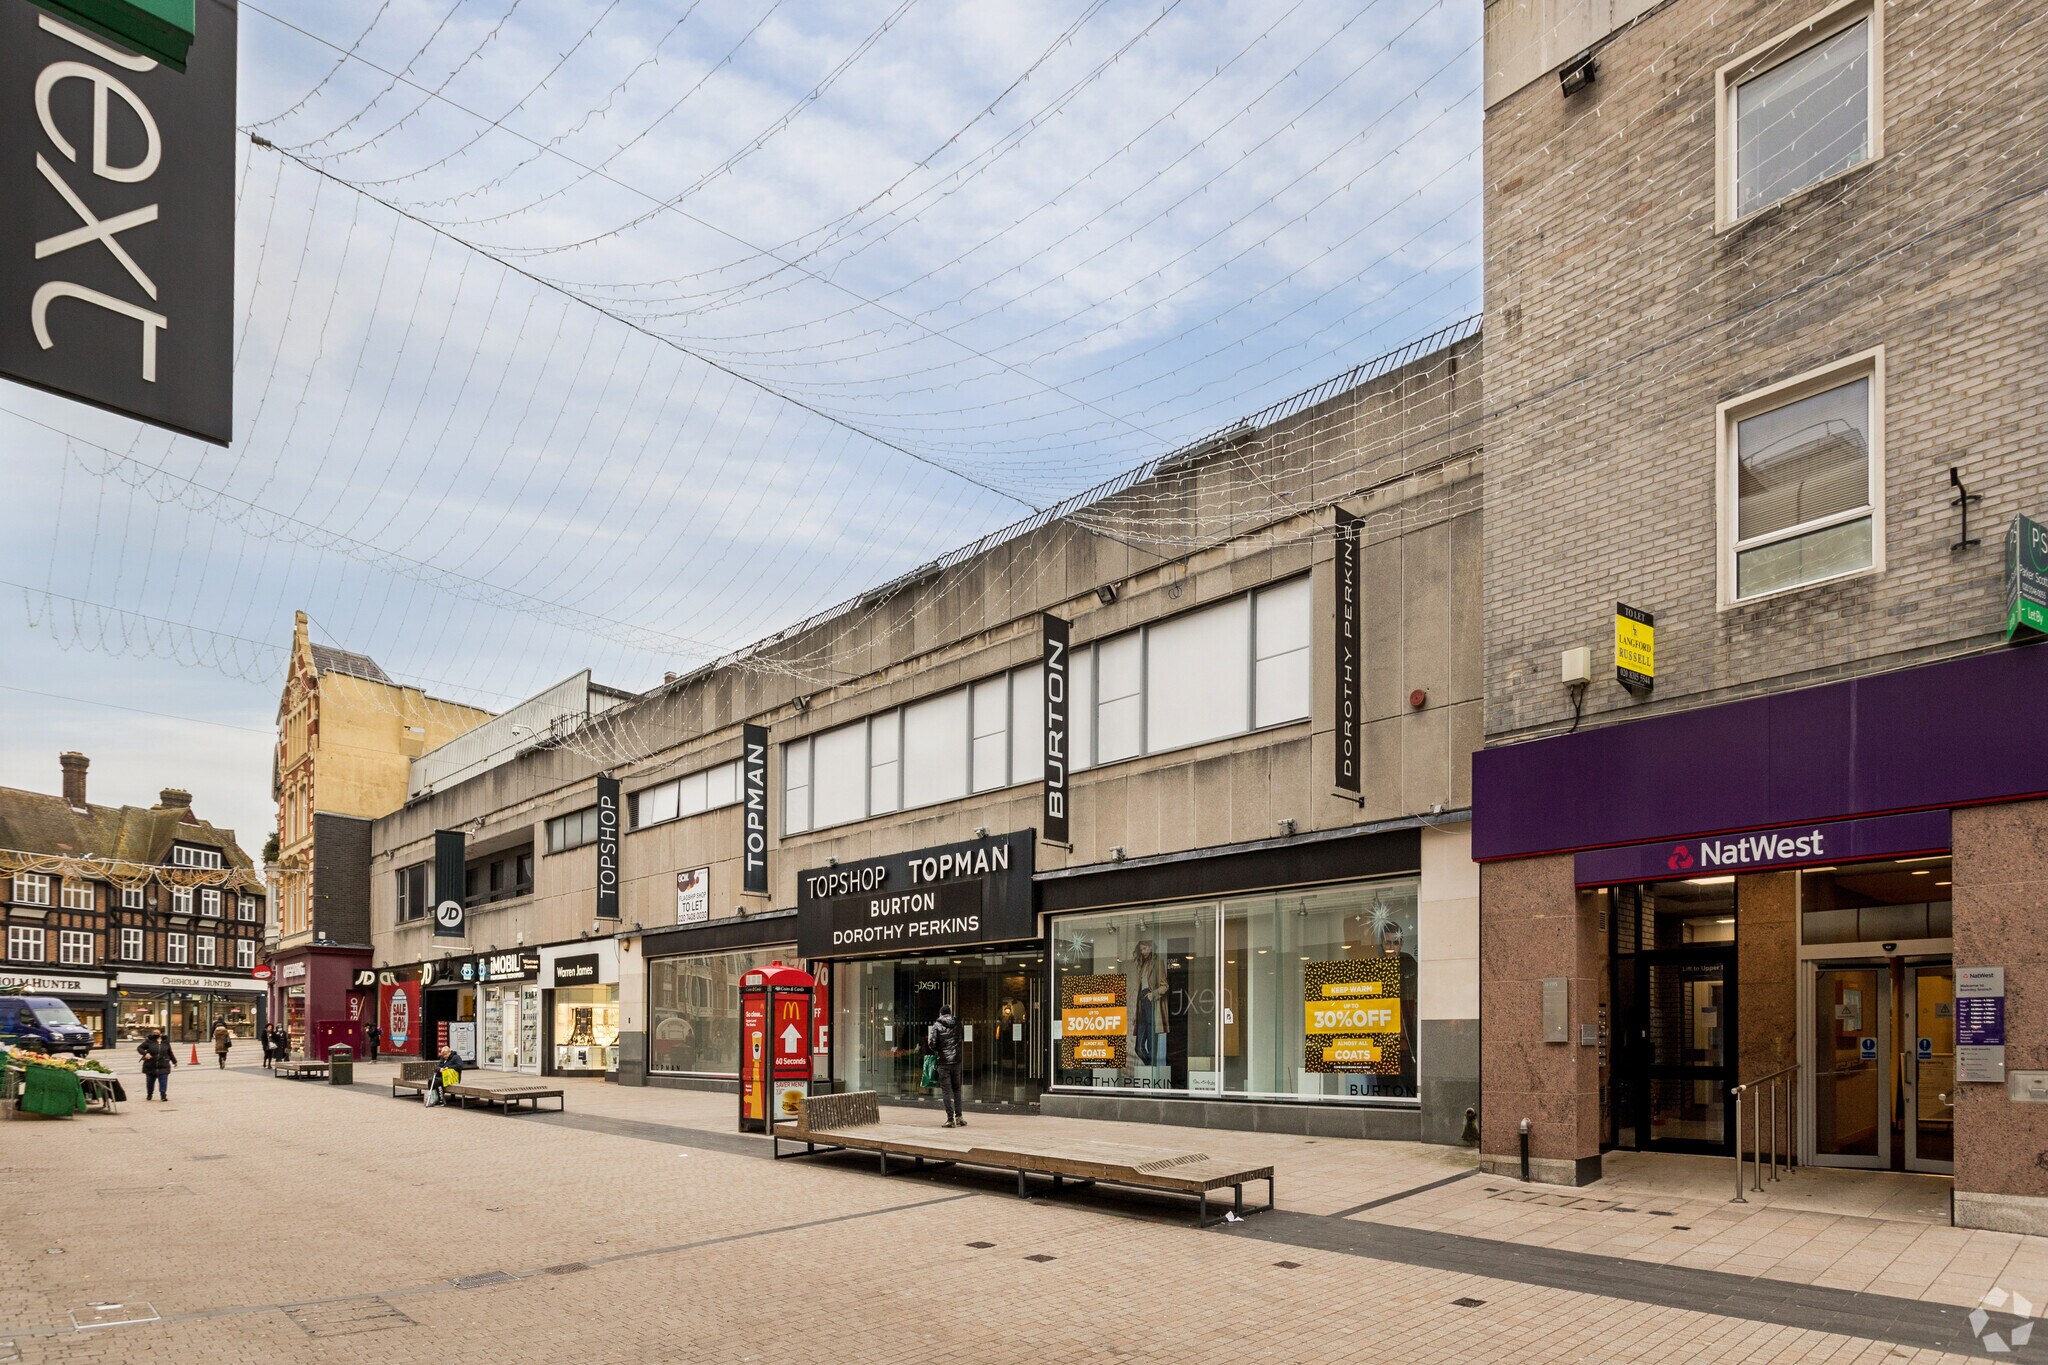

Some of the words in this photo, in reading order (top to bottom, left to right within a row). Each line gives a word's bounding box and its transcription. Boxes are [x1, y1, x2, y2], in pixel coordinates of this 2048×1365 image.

[1343, 524, 1352, 638] PERKINS
[1625, 607, 1633, 617] TO
[1634, 610, 1645, 622] LET
[1619, 634, 1651, 653] LANGFORD
[1619, 648, 1651, 667] RUSSELL
[1343, 646, 1352, 777] DOROTHY
[1048, 638, 1063, 819] BURTON
[747, 743, 764, 871] TOPMAN
[601, 795, 615, 898] TOPSHOP
[1701, 829, 1824, 867] NatWest
[807, 866, 885, 899] TOPSHOP
[909, 844, 1009, 884] TOPMAN
[441, 907, 459, 921] JD
[682, 902, 690, 912] TO
[692, 899, 703, 911] LET
[870, 892, 935, 918] BURTON
[833, 924, 904, 945] DOROTHY
[908, 916, 980, 937] PERKINS
[355, 971, 376, 985] JD
[421, 963, 432, 985] JD
[557, 967, 575, 978] Warren
[576, 965, 593, 976] James
[0, 977, 28, 986] OLM
[33, 978, 81, 990] HUNTER
[162, 977, 200, 986] CHISHOLM
[204, 979, 232, 987] HUNTER
[1350, 985, 1372, 993] WARM
[1081, 1049, 1106, 1057] COATS
[1335, 1050, 1370, 1060] COATS
[1350, 1084, 1417, 1097] BURTON
